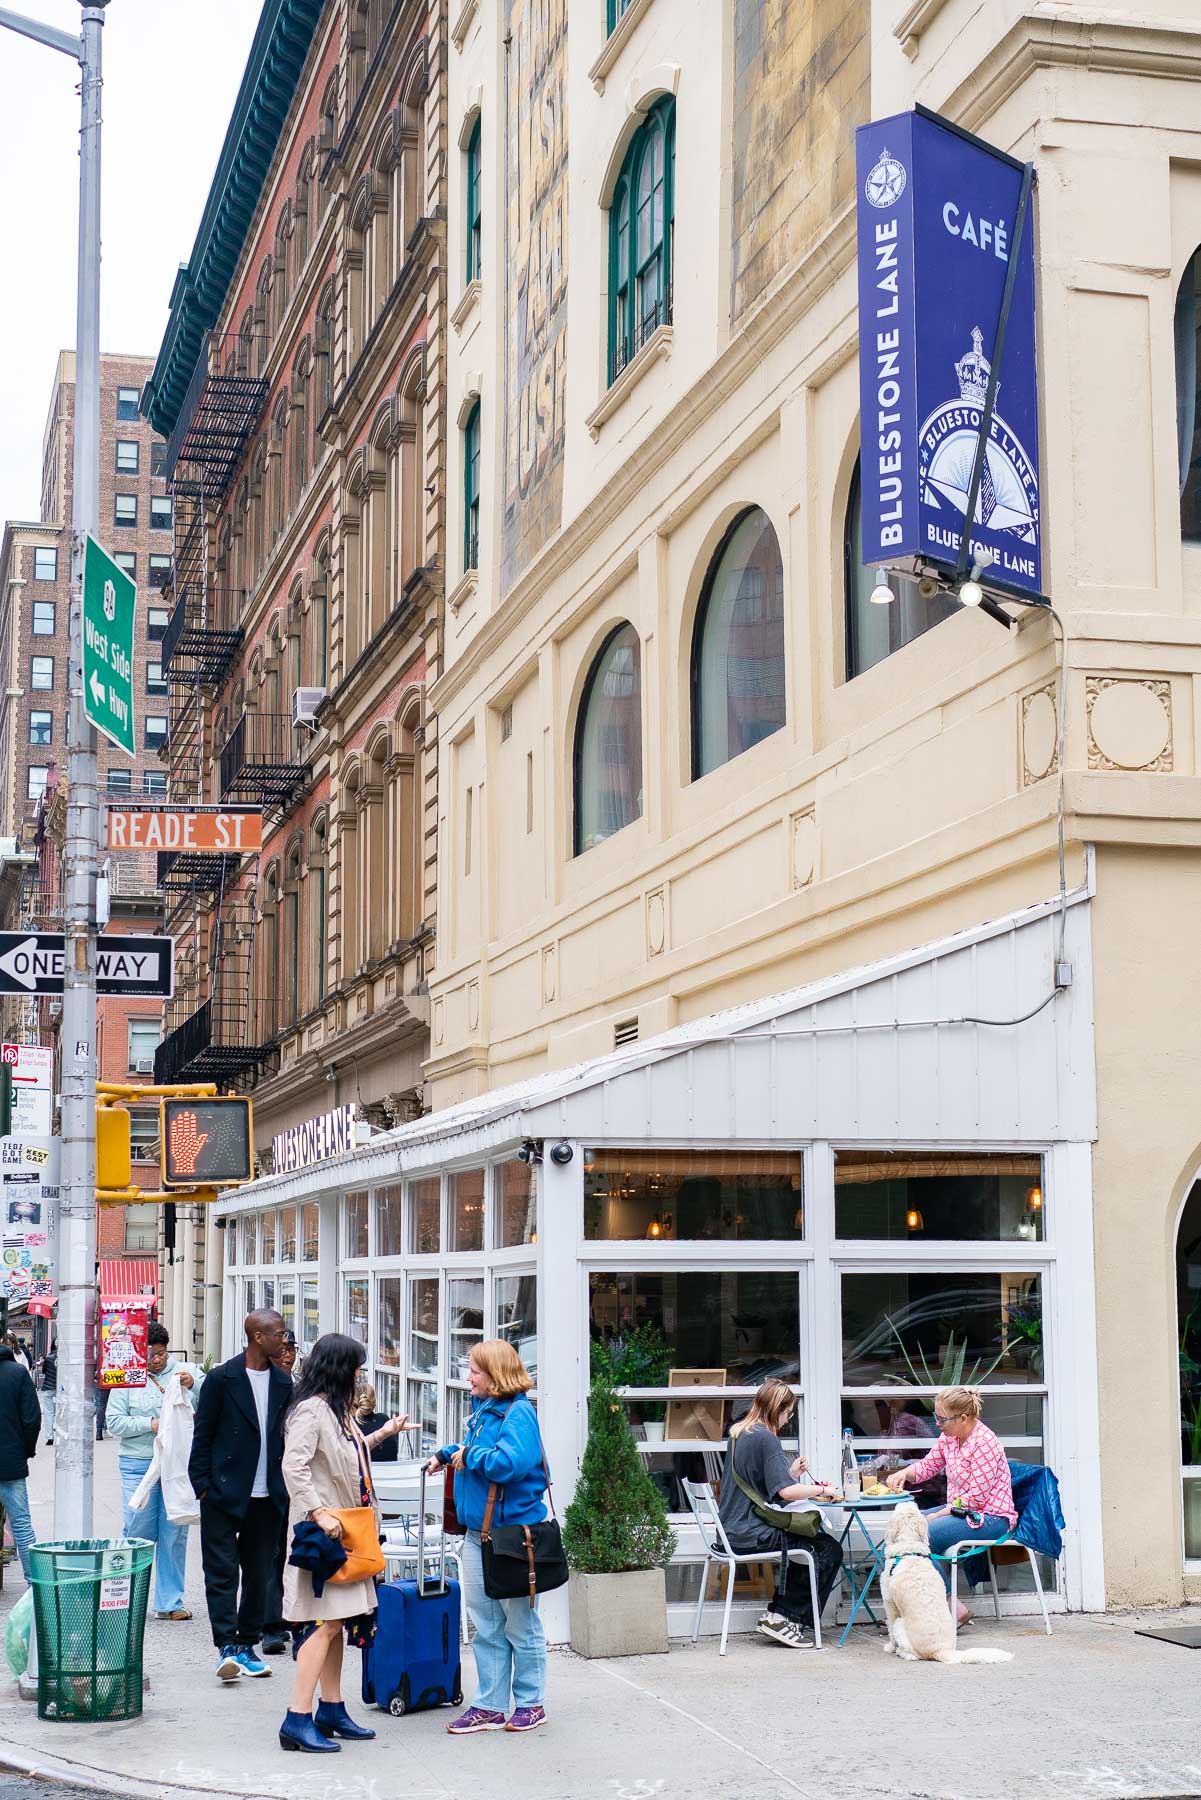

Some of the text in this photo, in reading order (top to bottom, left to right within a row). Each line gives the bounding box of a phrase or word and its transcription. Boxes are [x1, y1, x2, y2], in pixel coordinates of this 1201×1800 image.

[942, 202, 1009, 263] CAFÉ
[875, 218, 900, 318] LANE
[877, 327, 904, 548] BLUESTONE
[925, 409, 1032, 488] BLUESTOE LANE
[1003, 551, 1036, 578] LANE
[86, 616, 130, 683] West Side
[108, 685, 129, 732] Hwy
[111, 813, 245, 849] READE ST
[112, 805, 139, 813] TRIBECA
[163, 806, 191, 814] HISTORIC
[14, 952, 148, 978] ONE WAY
[2, 1156, 23, 1164] GAME
[271, 1103, 357, 1176] BLUESTONE LANE
